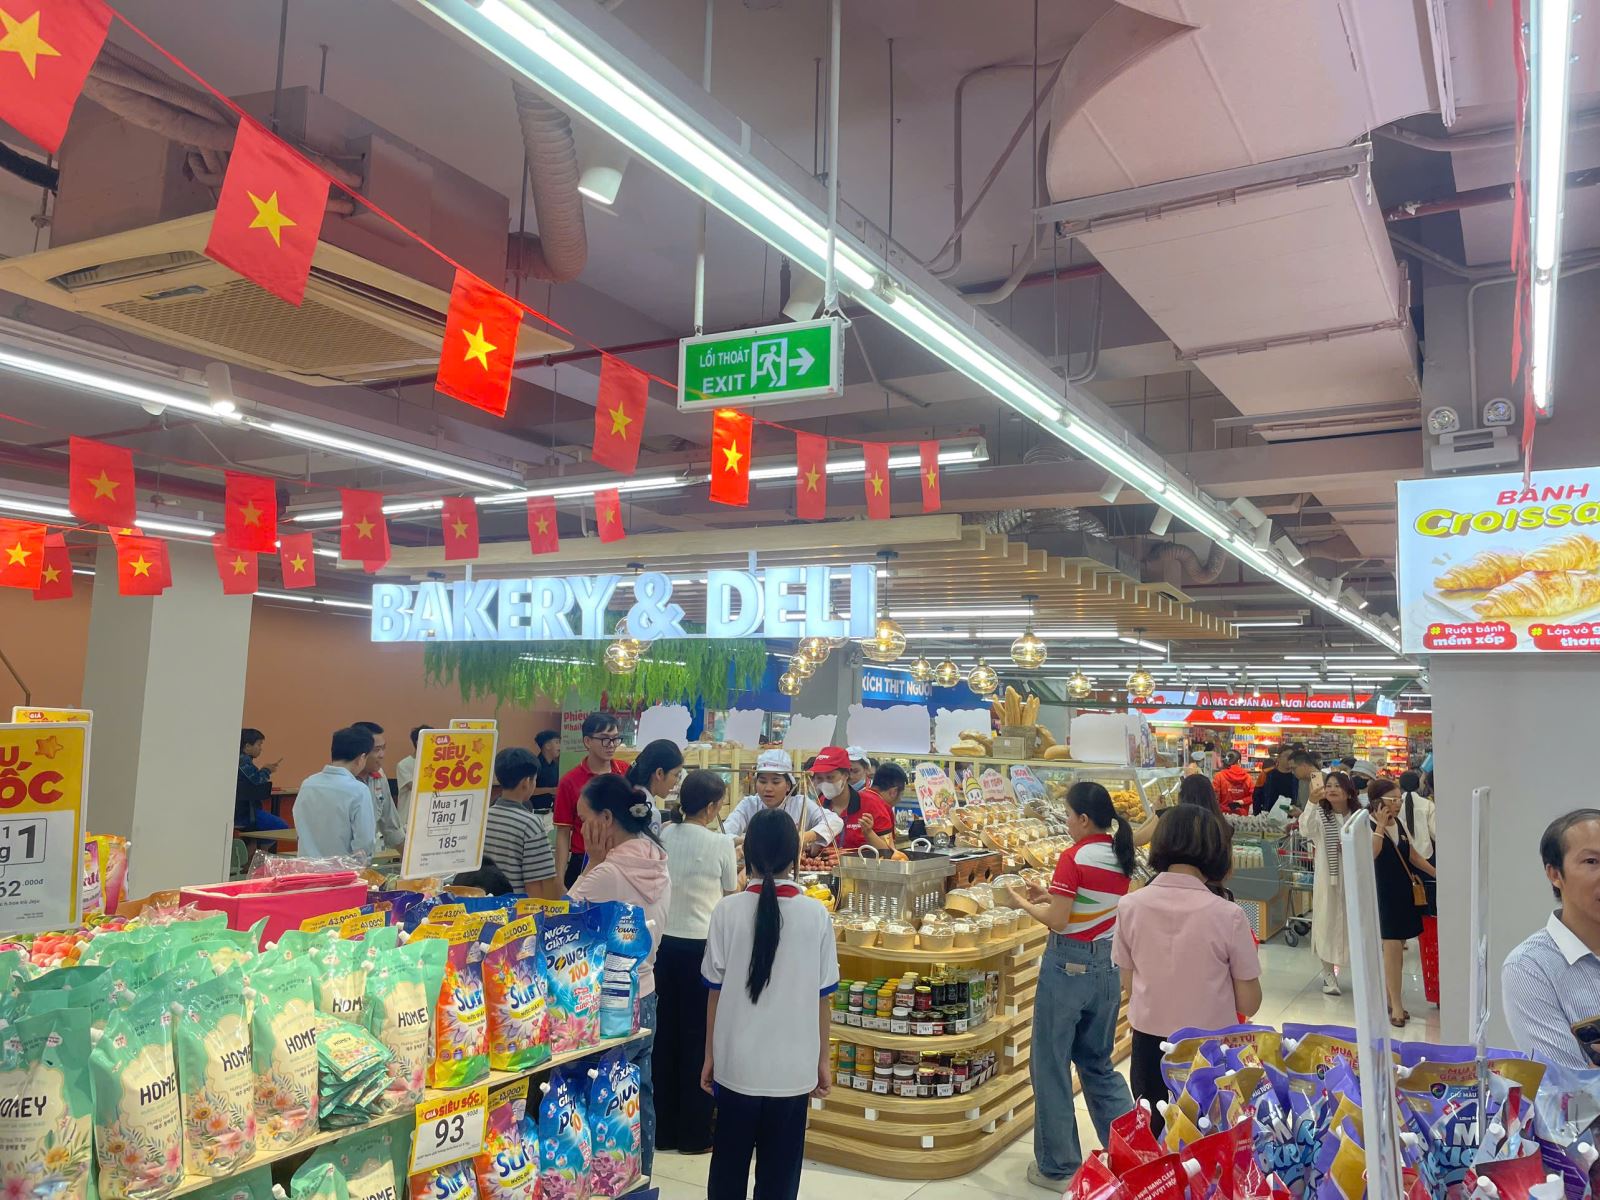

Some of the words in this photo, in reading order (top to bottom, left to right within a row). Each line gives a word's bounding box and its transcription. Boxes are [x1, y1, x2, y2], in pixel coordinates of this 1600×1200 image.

[700, 347, 716, 368] LỐI
[718, 346, 750, 366] THOÁT
[702, 373, 746, 394] EXIT
[1496, 483, 1590, 506] BÁNH
[371, 575, 623, 642] BAKERY
[626, 571, 686, 640] &
[706, 563, 877, 639] DELI
[1433, 634, 1472, 647] mềm
[1475, 633, 1505, 646] xốp
[1445, 625, 1473, 636] Ruột
[1476, 624, 1505, 634] bánh
[885, 678, 905, 698] THỊT
[1281, 699, 1302, 708] ƯƠI
[436, 736, 448, 744] GIÁ
[433, 742, 467, 762] SIÊU
[433, 756, 484, 790] SỐC
[432, 800, 451, 810] Mua
[459, 798, 469, 822] 1
[432, 810, 456, 826] Tặng
[18, 824, 36, 859] 1
[438, 836, 458, 849] 185
[544, 924, 572, 941] NƯỚC
[614, 925, 639, 934] Power
[546, 943, 590, 972] Power
[568, 961, 589, 983] 100
[398, 1007, 428, 1028] HOME
[438, 1100, 460, 1117] SIÊU
[461, 1090, 480, 1108] SỐC
[435, 1115, 465, 1148] 93
